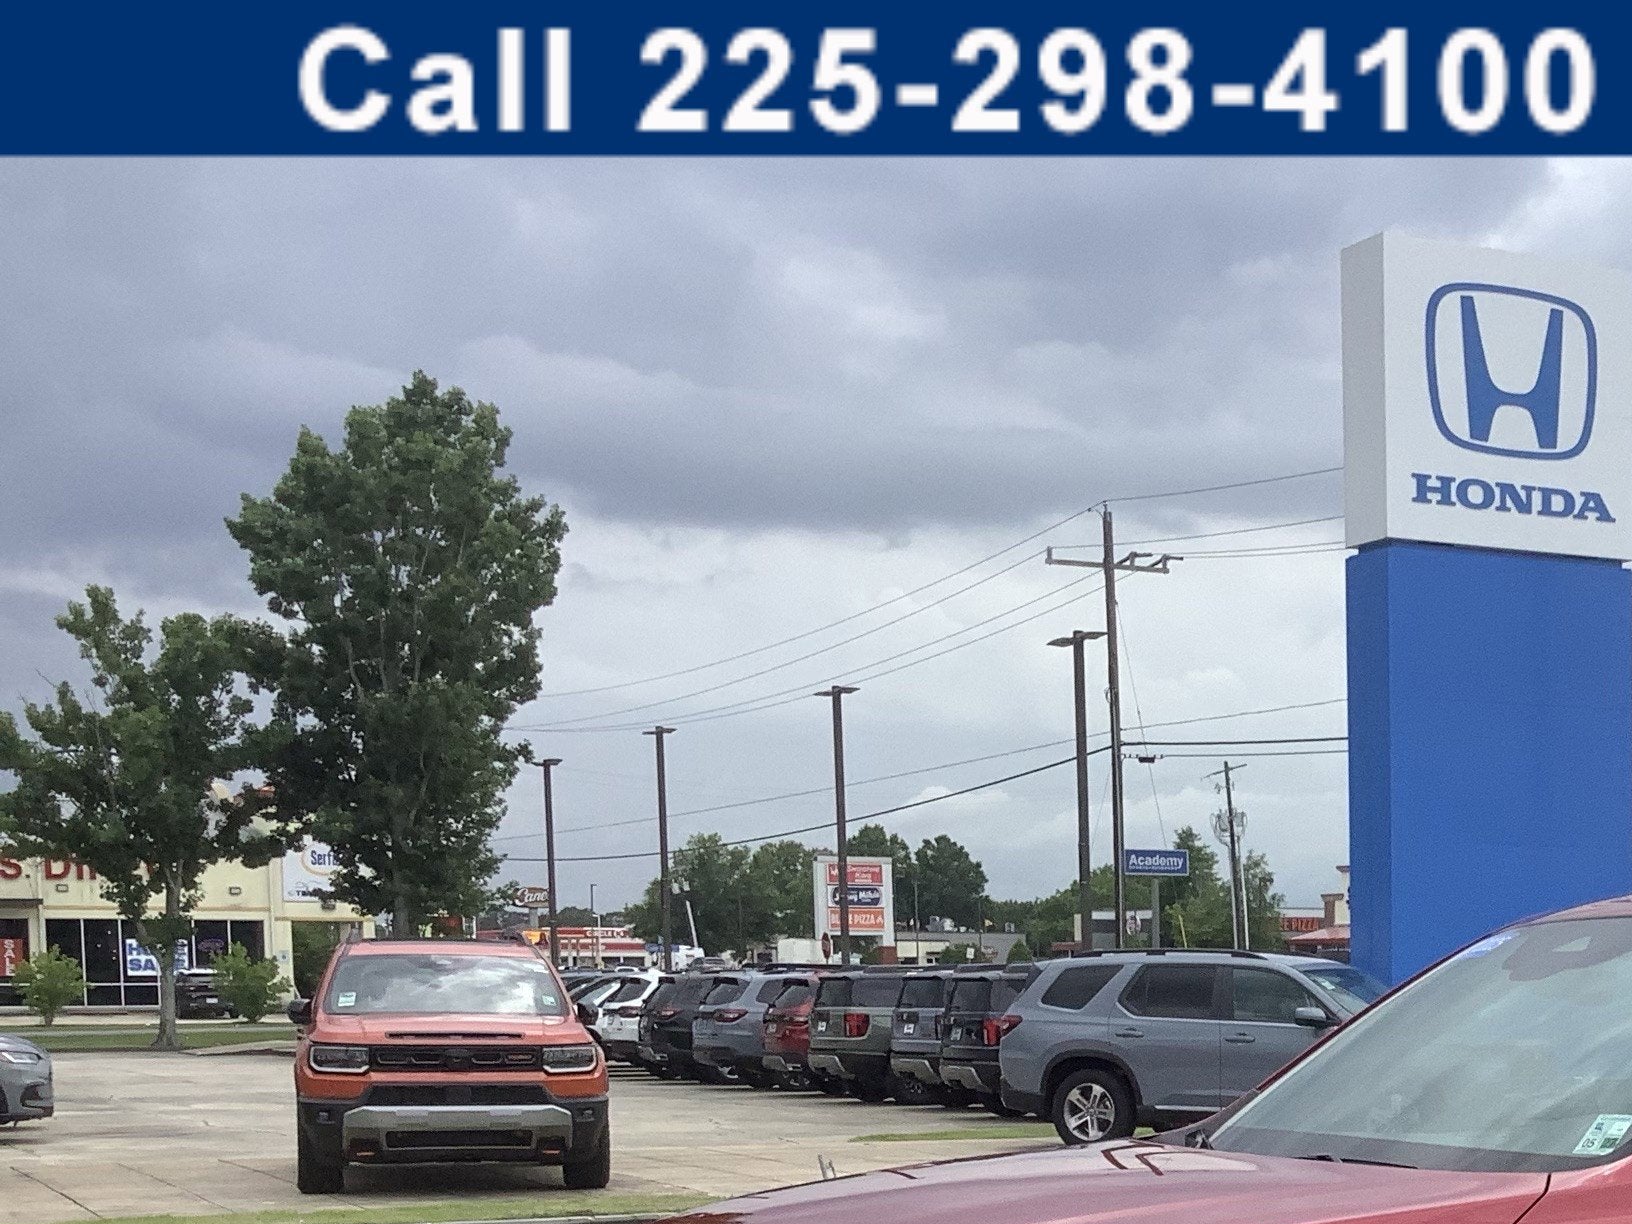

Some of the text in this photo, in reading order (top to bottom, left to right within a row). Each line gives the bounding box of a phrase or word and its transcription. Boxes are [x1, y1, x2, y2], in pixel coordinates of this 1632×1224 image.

[1411, 472, 1616, 524] HONDA
[1129, 854, 1183, 869] Academy
[515, 888, 549, 906] Cane
